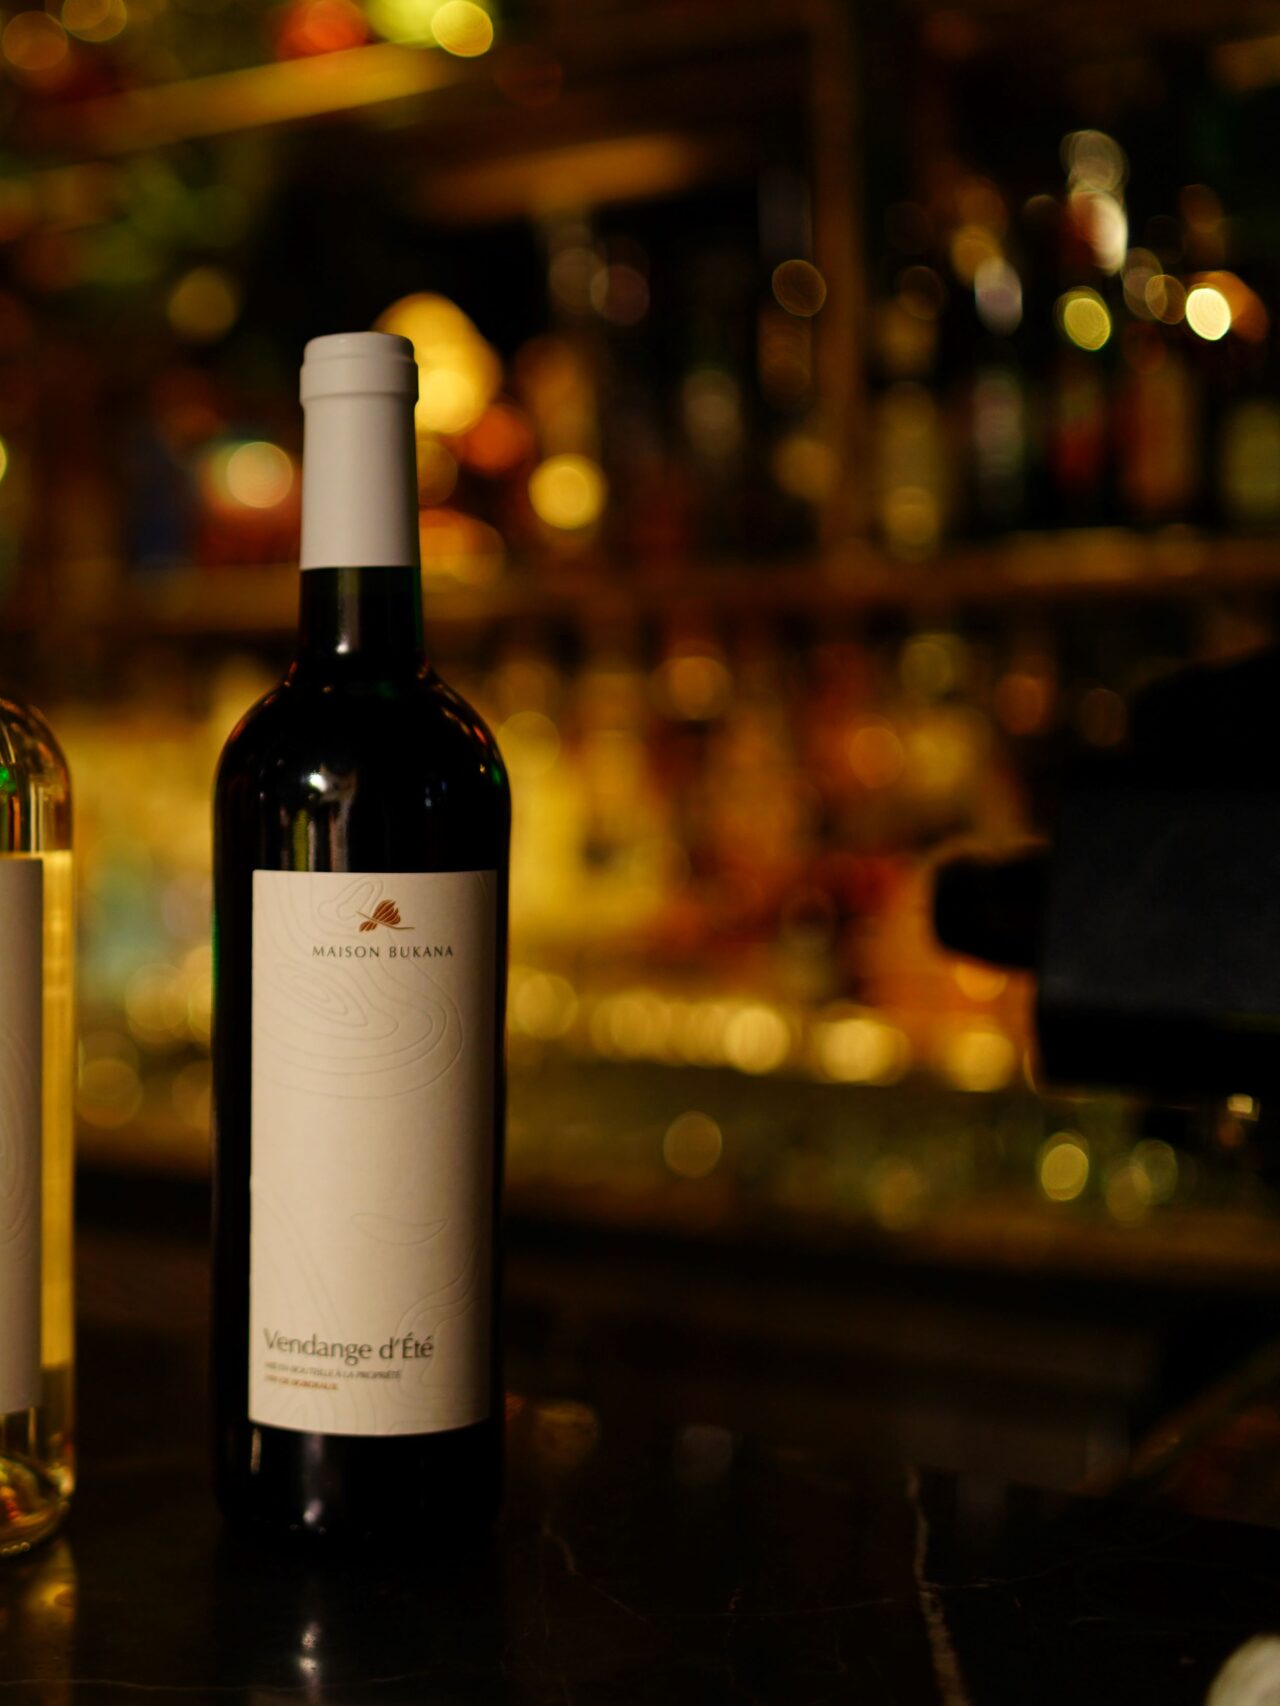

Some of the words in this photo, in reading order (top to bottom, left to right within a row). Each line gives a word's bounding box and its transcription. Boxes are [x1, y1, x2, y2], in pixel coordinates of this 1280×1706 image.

[312, 945, 380, 958] MAISON
[389, 945, 454, 958] BUKANA
[263, 1328, 373, 1366] Vendange
